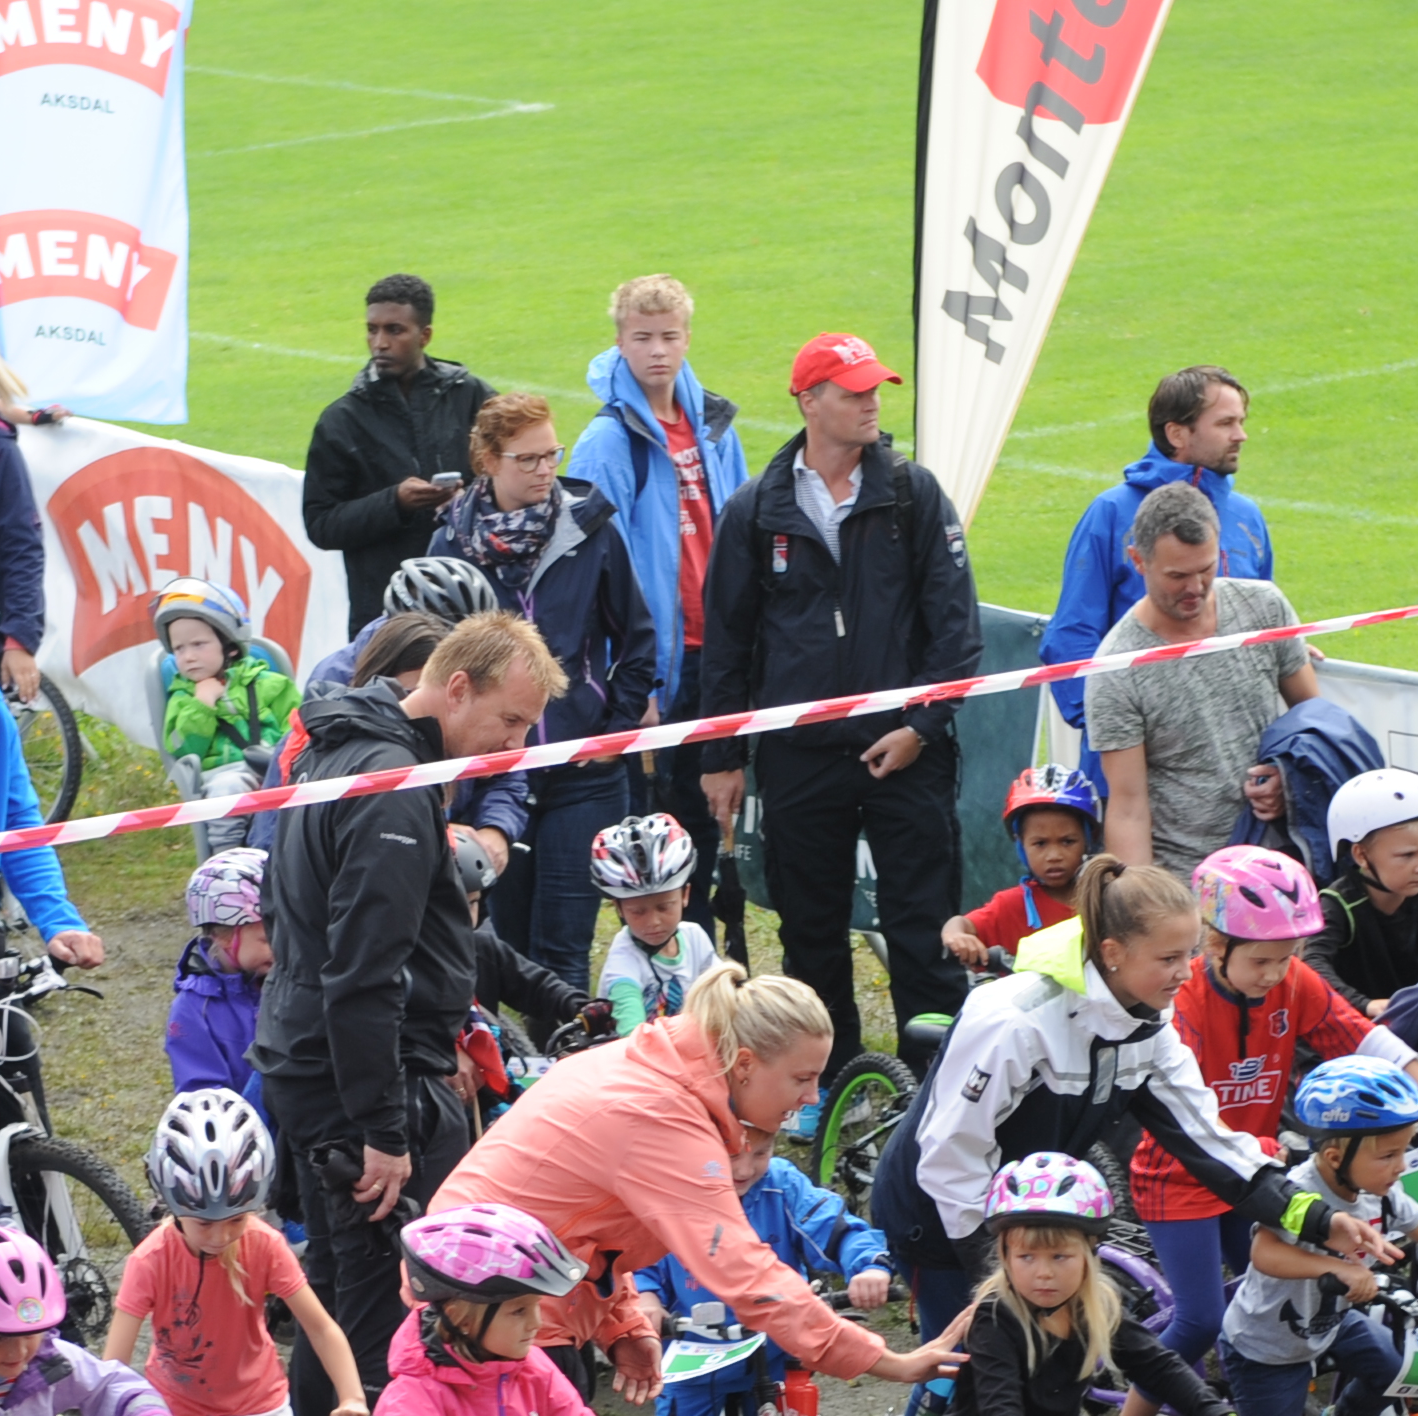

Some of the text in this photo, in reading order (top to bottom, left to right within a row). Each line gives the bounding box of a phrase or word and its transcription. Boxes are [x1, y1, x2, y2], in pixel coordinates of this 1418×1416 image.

[39, 92, 116, 114] AKSDAL
[34, 325, 107, 346] AKSDAL
[77, 495, 285, 637] MENY
[1218, 1078, 1272, 1103] TINE
